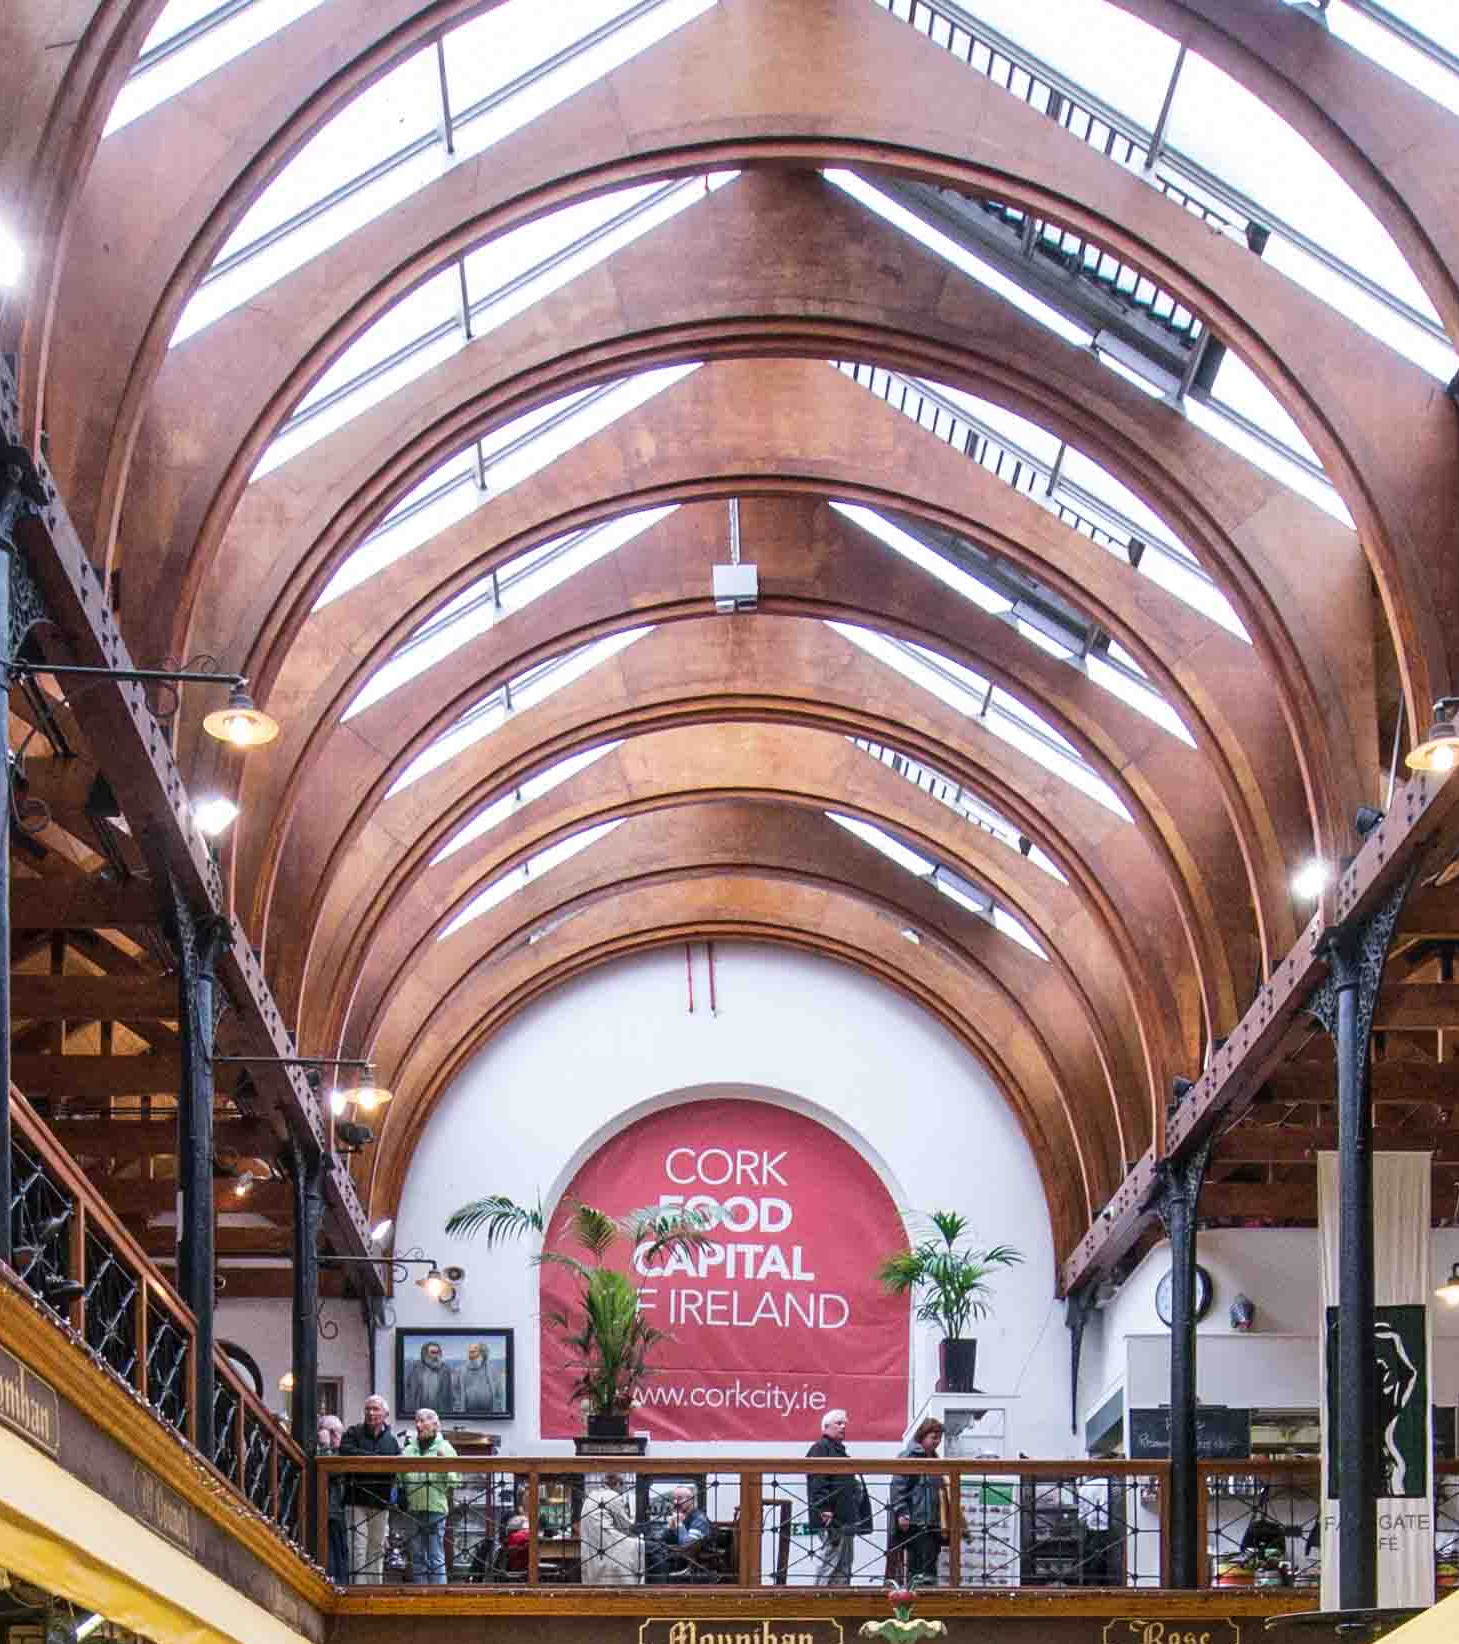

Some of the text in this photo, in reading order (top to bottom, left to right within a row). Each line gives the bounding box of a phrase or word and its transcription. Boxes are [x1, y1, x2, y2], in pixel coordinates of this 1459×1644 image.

[665, 1148, 789, 1186] CORK
[658, 1194, 793, 1233] FOOD
[634, 1240, 815, 1281] CAPITAL
[668, 1289, 851, 1329] IRELAND
[619, 1379, 827, 1417] ww.corkcity.ie
[1325, 1513, 1430, 1531] FGATE
